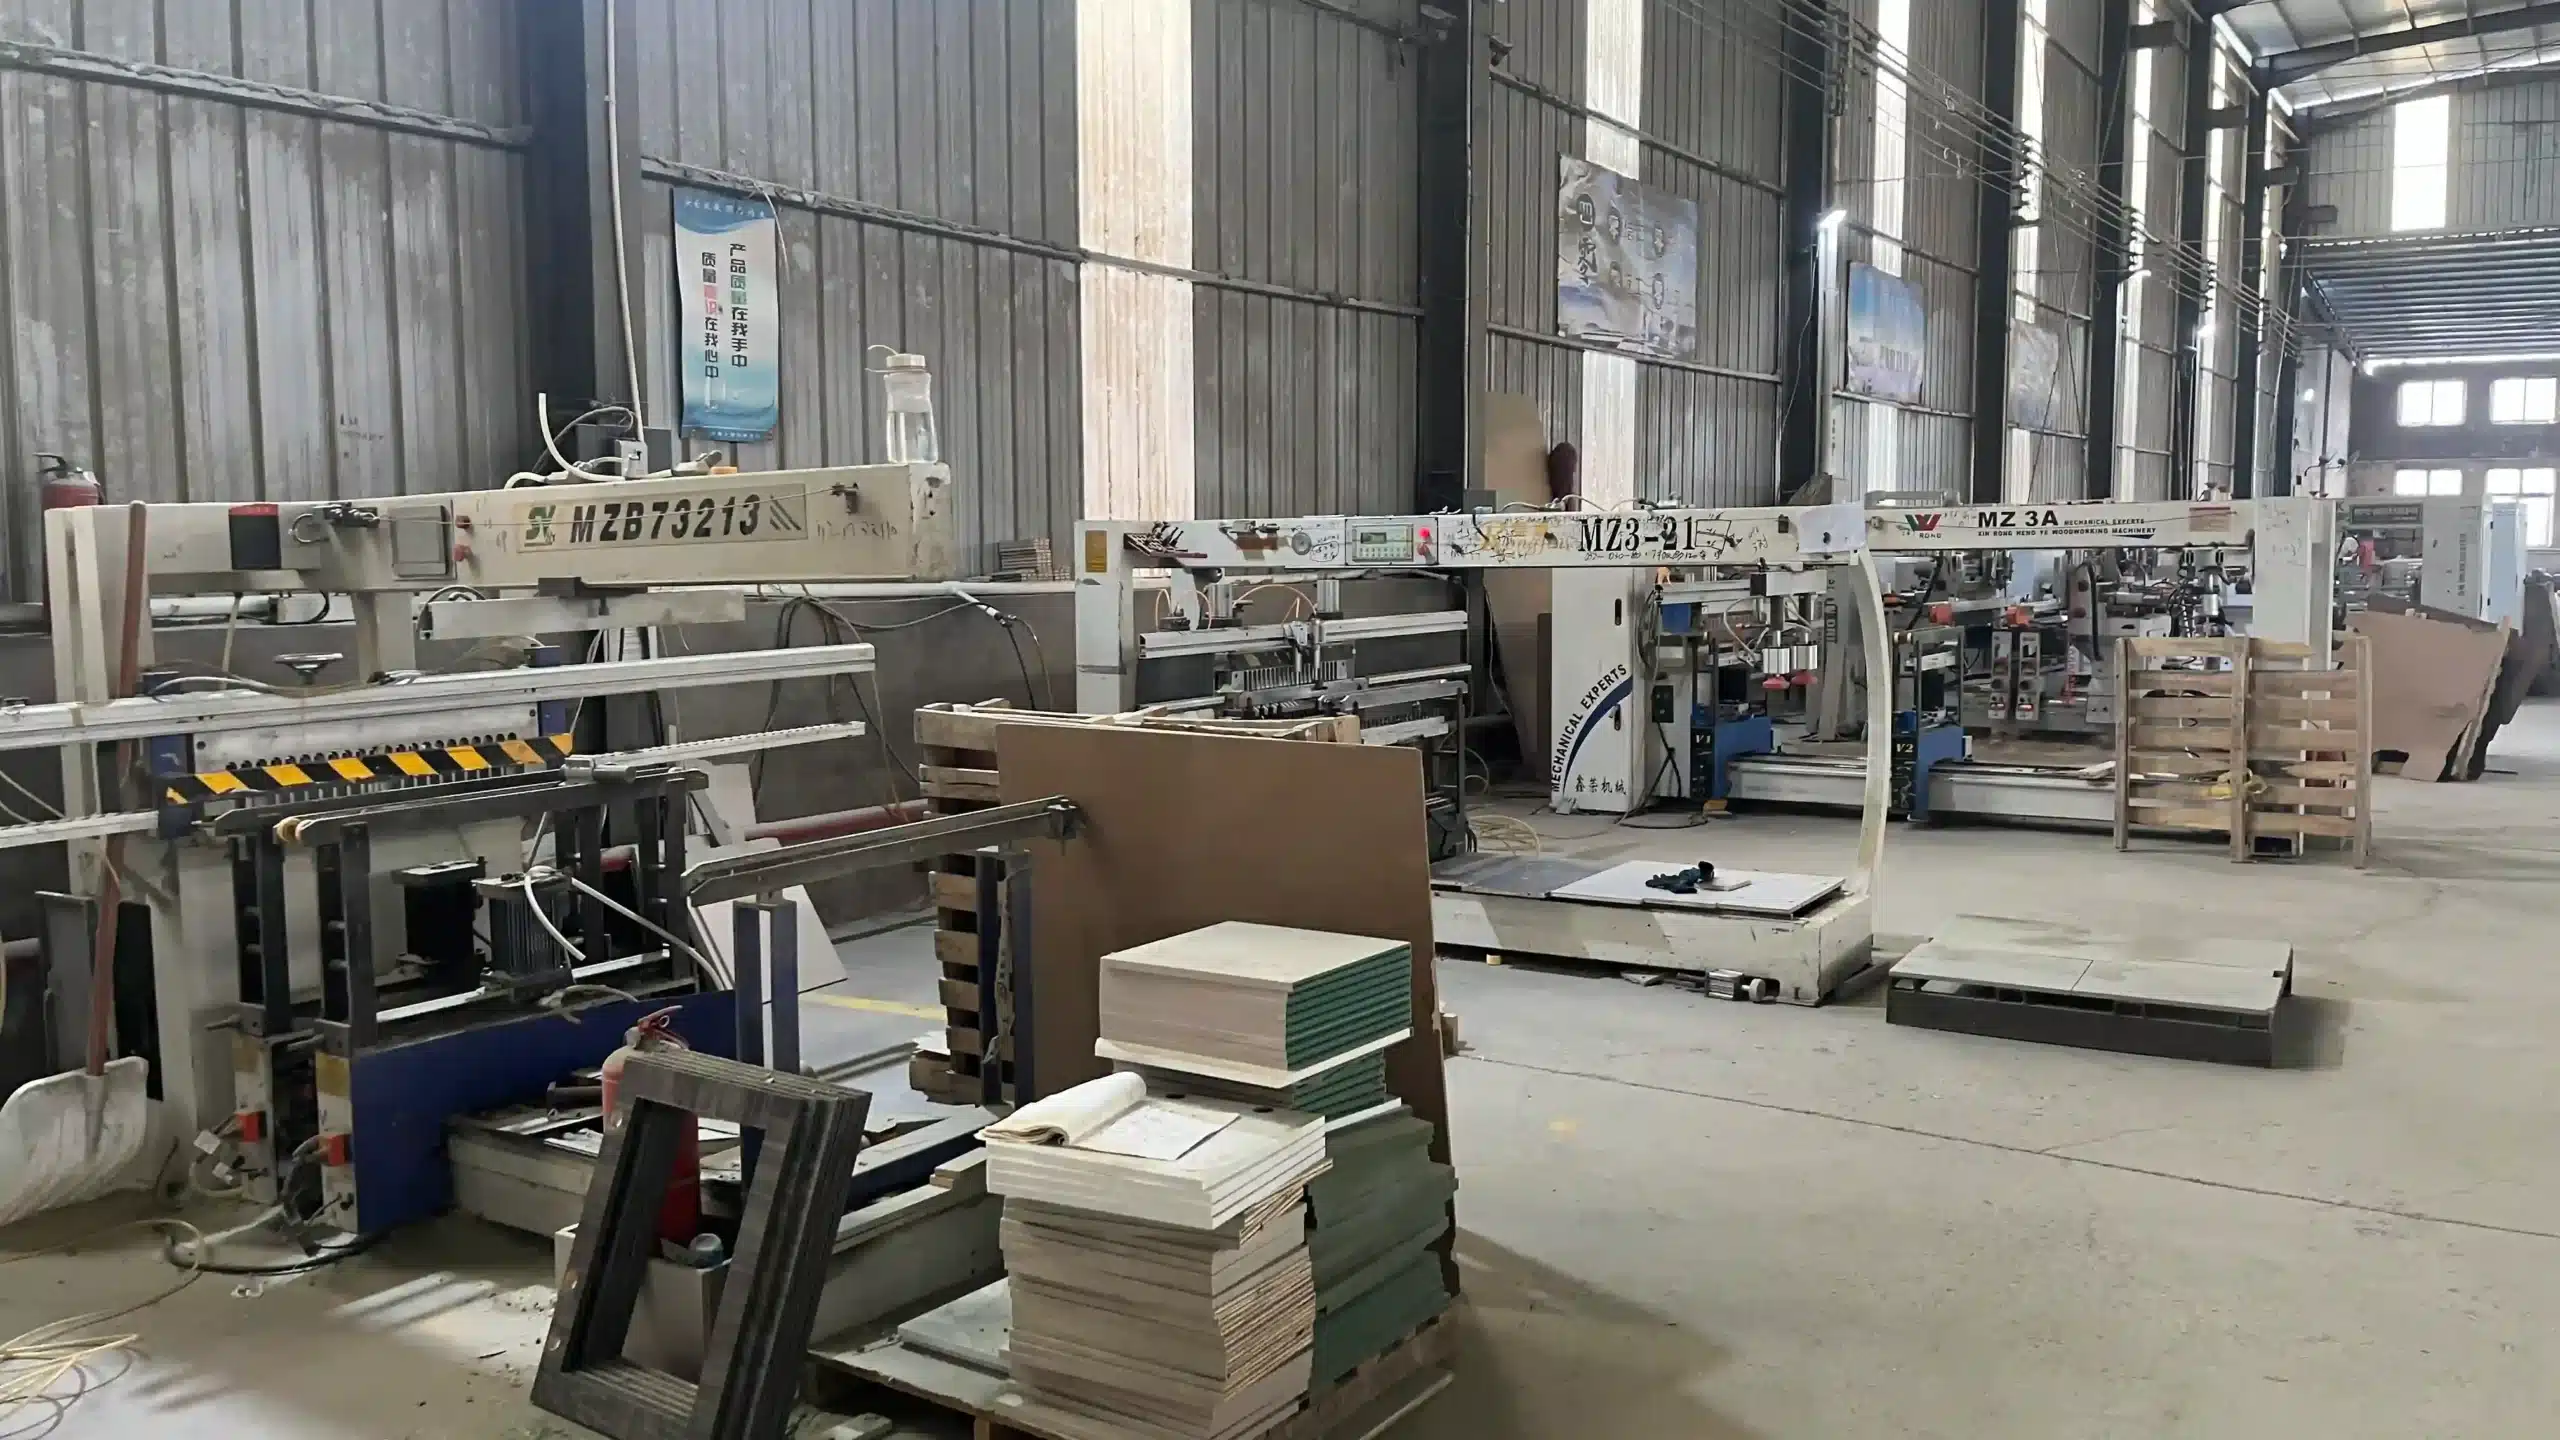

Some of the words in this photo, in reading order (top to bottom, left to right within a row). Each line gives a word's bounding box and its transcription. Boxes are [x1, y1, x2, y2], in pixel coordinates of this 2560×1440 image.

[569, 494, 761, 544] MZB73213
[1577, 515, 1696, 552] MZ3-21
[1978, 511, 2016, 528] MZ
[2024, 509, 2059, 527] 3A
[1551, 712, 1584, 793] MECHANICAL
[1579, 663, 1628, 710] EXPERTS
[1896, 743, 1914, 753] V2
